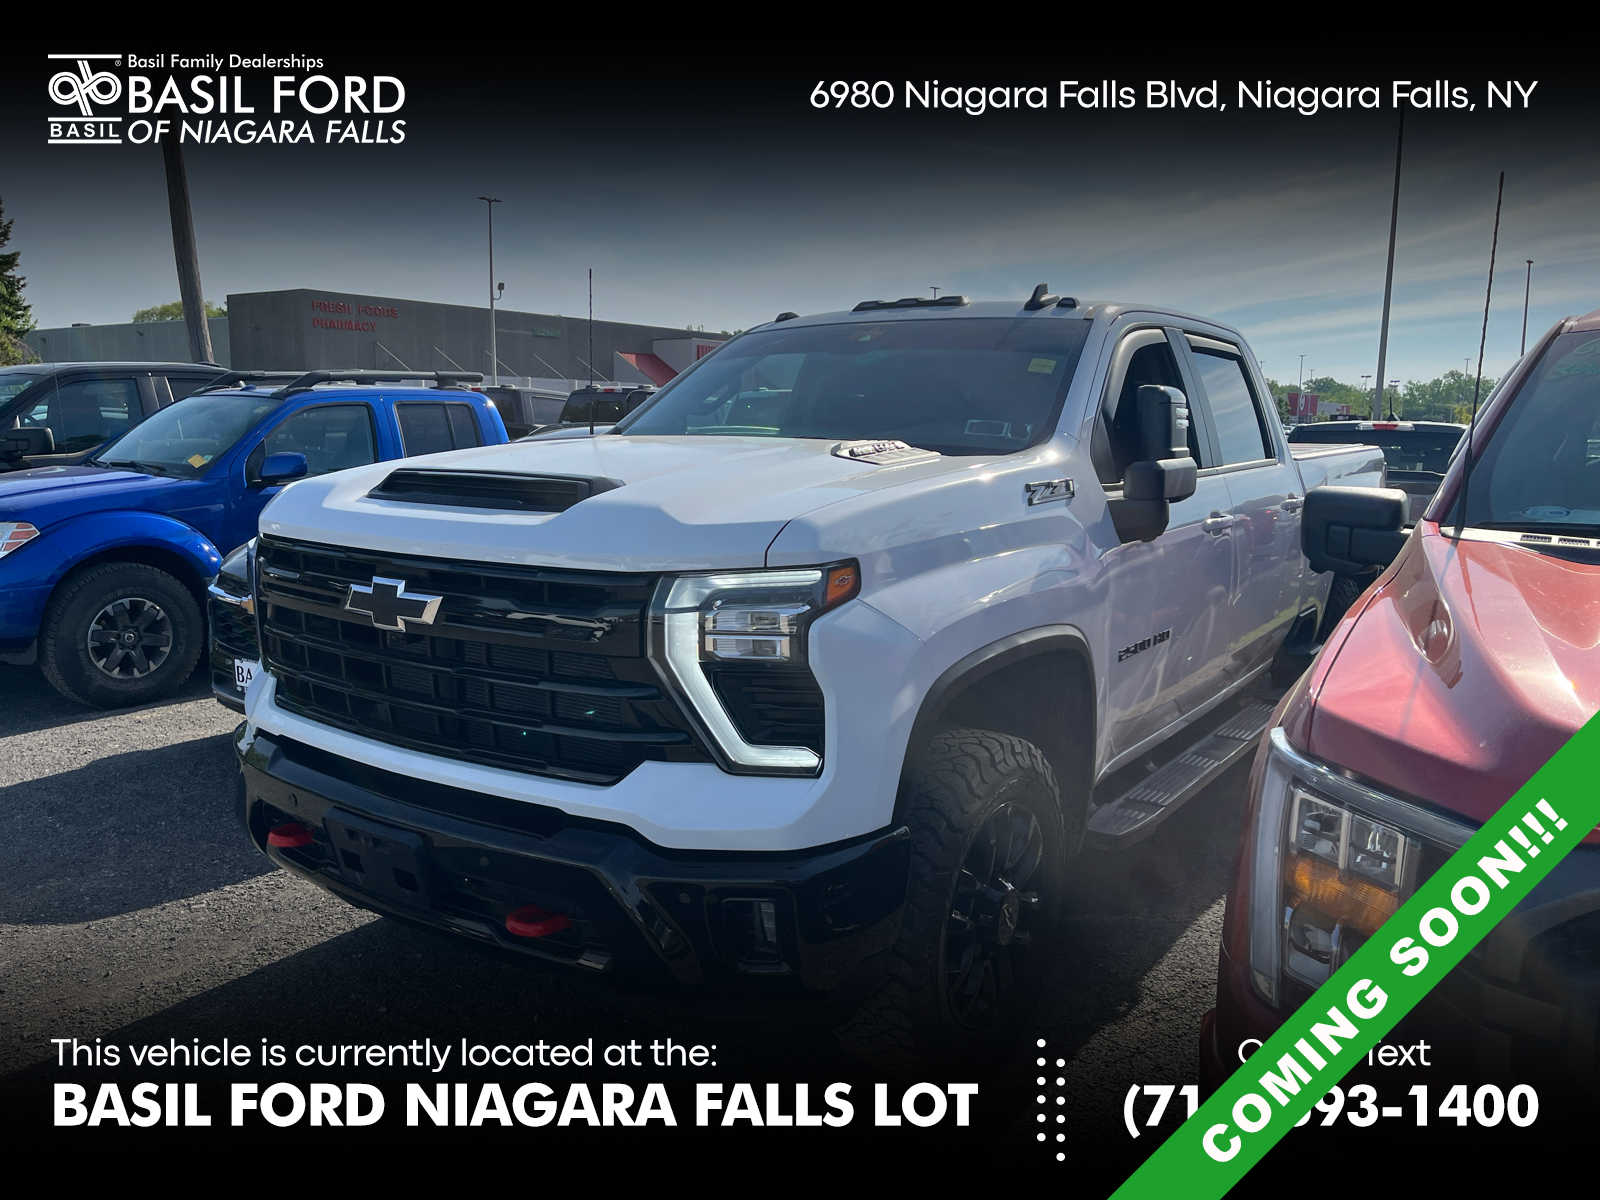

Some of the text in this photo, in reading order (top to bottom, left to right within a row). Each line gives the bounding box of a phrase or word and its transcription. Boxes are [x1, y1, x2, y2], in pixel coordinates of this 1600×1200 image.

[312, 300, 399, 319] FRESH FOODS
[312, 317, 377, 332] PHARMACY
